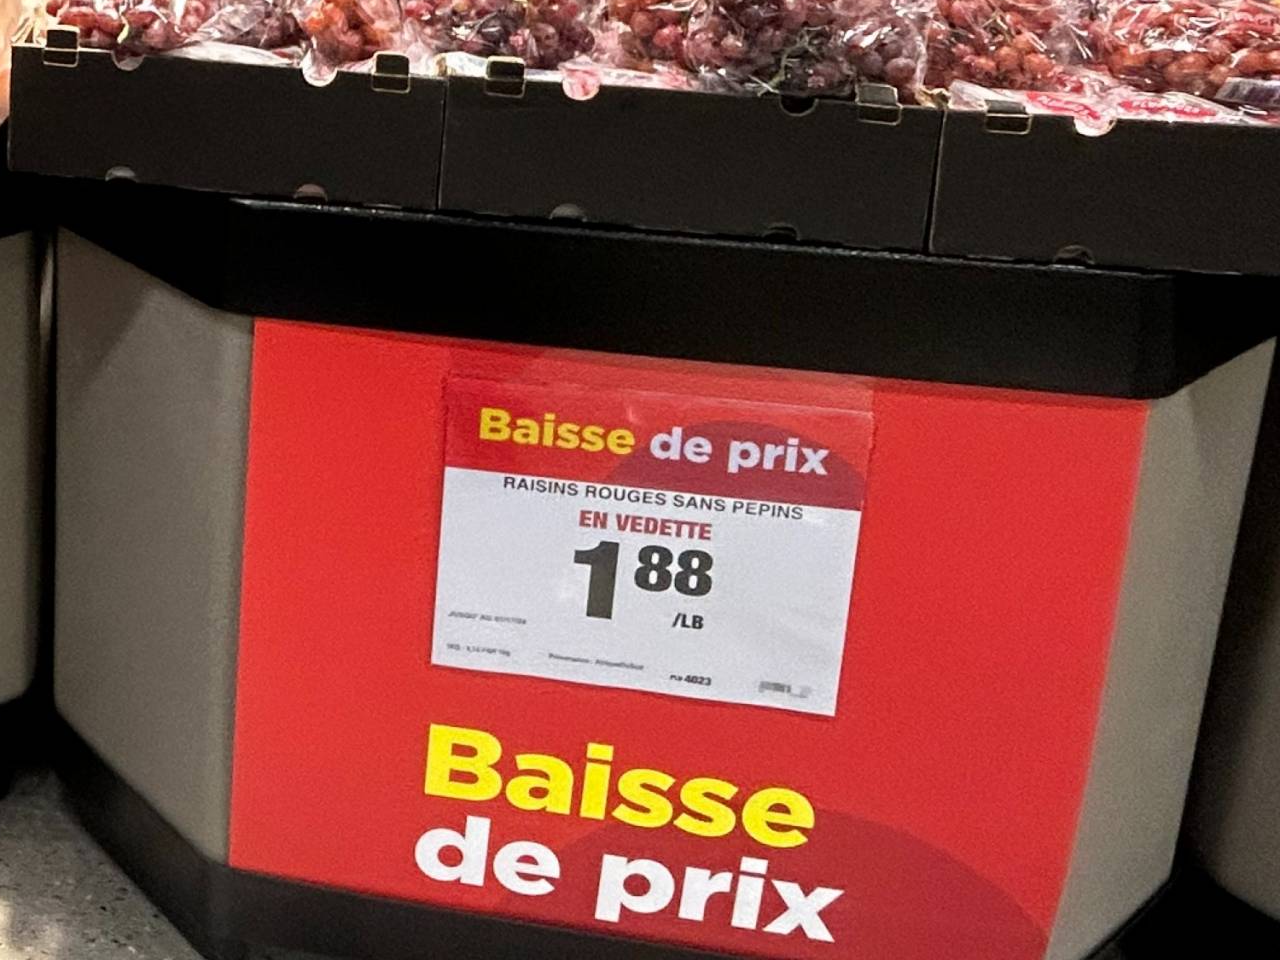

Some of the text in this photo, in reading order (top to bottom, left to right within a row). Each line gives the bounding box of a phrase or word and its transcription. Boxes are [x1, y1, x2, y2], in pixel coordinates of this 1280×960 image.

[479, 407, 829, 475] Baisse de prix
[503, 477, 804, 521] RAISINS ROUGES SANS PEPINS
[579, 510, 713, 540] EN VEDETTE
[672, 612, 705, 630] /LB
[684, 675, 712, 687] 4023
[423, 722, 816, 849] Baisse
[413, 815, 845, 944] de prix
